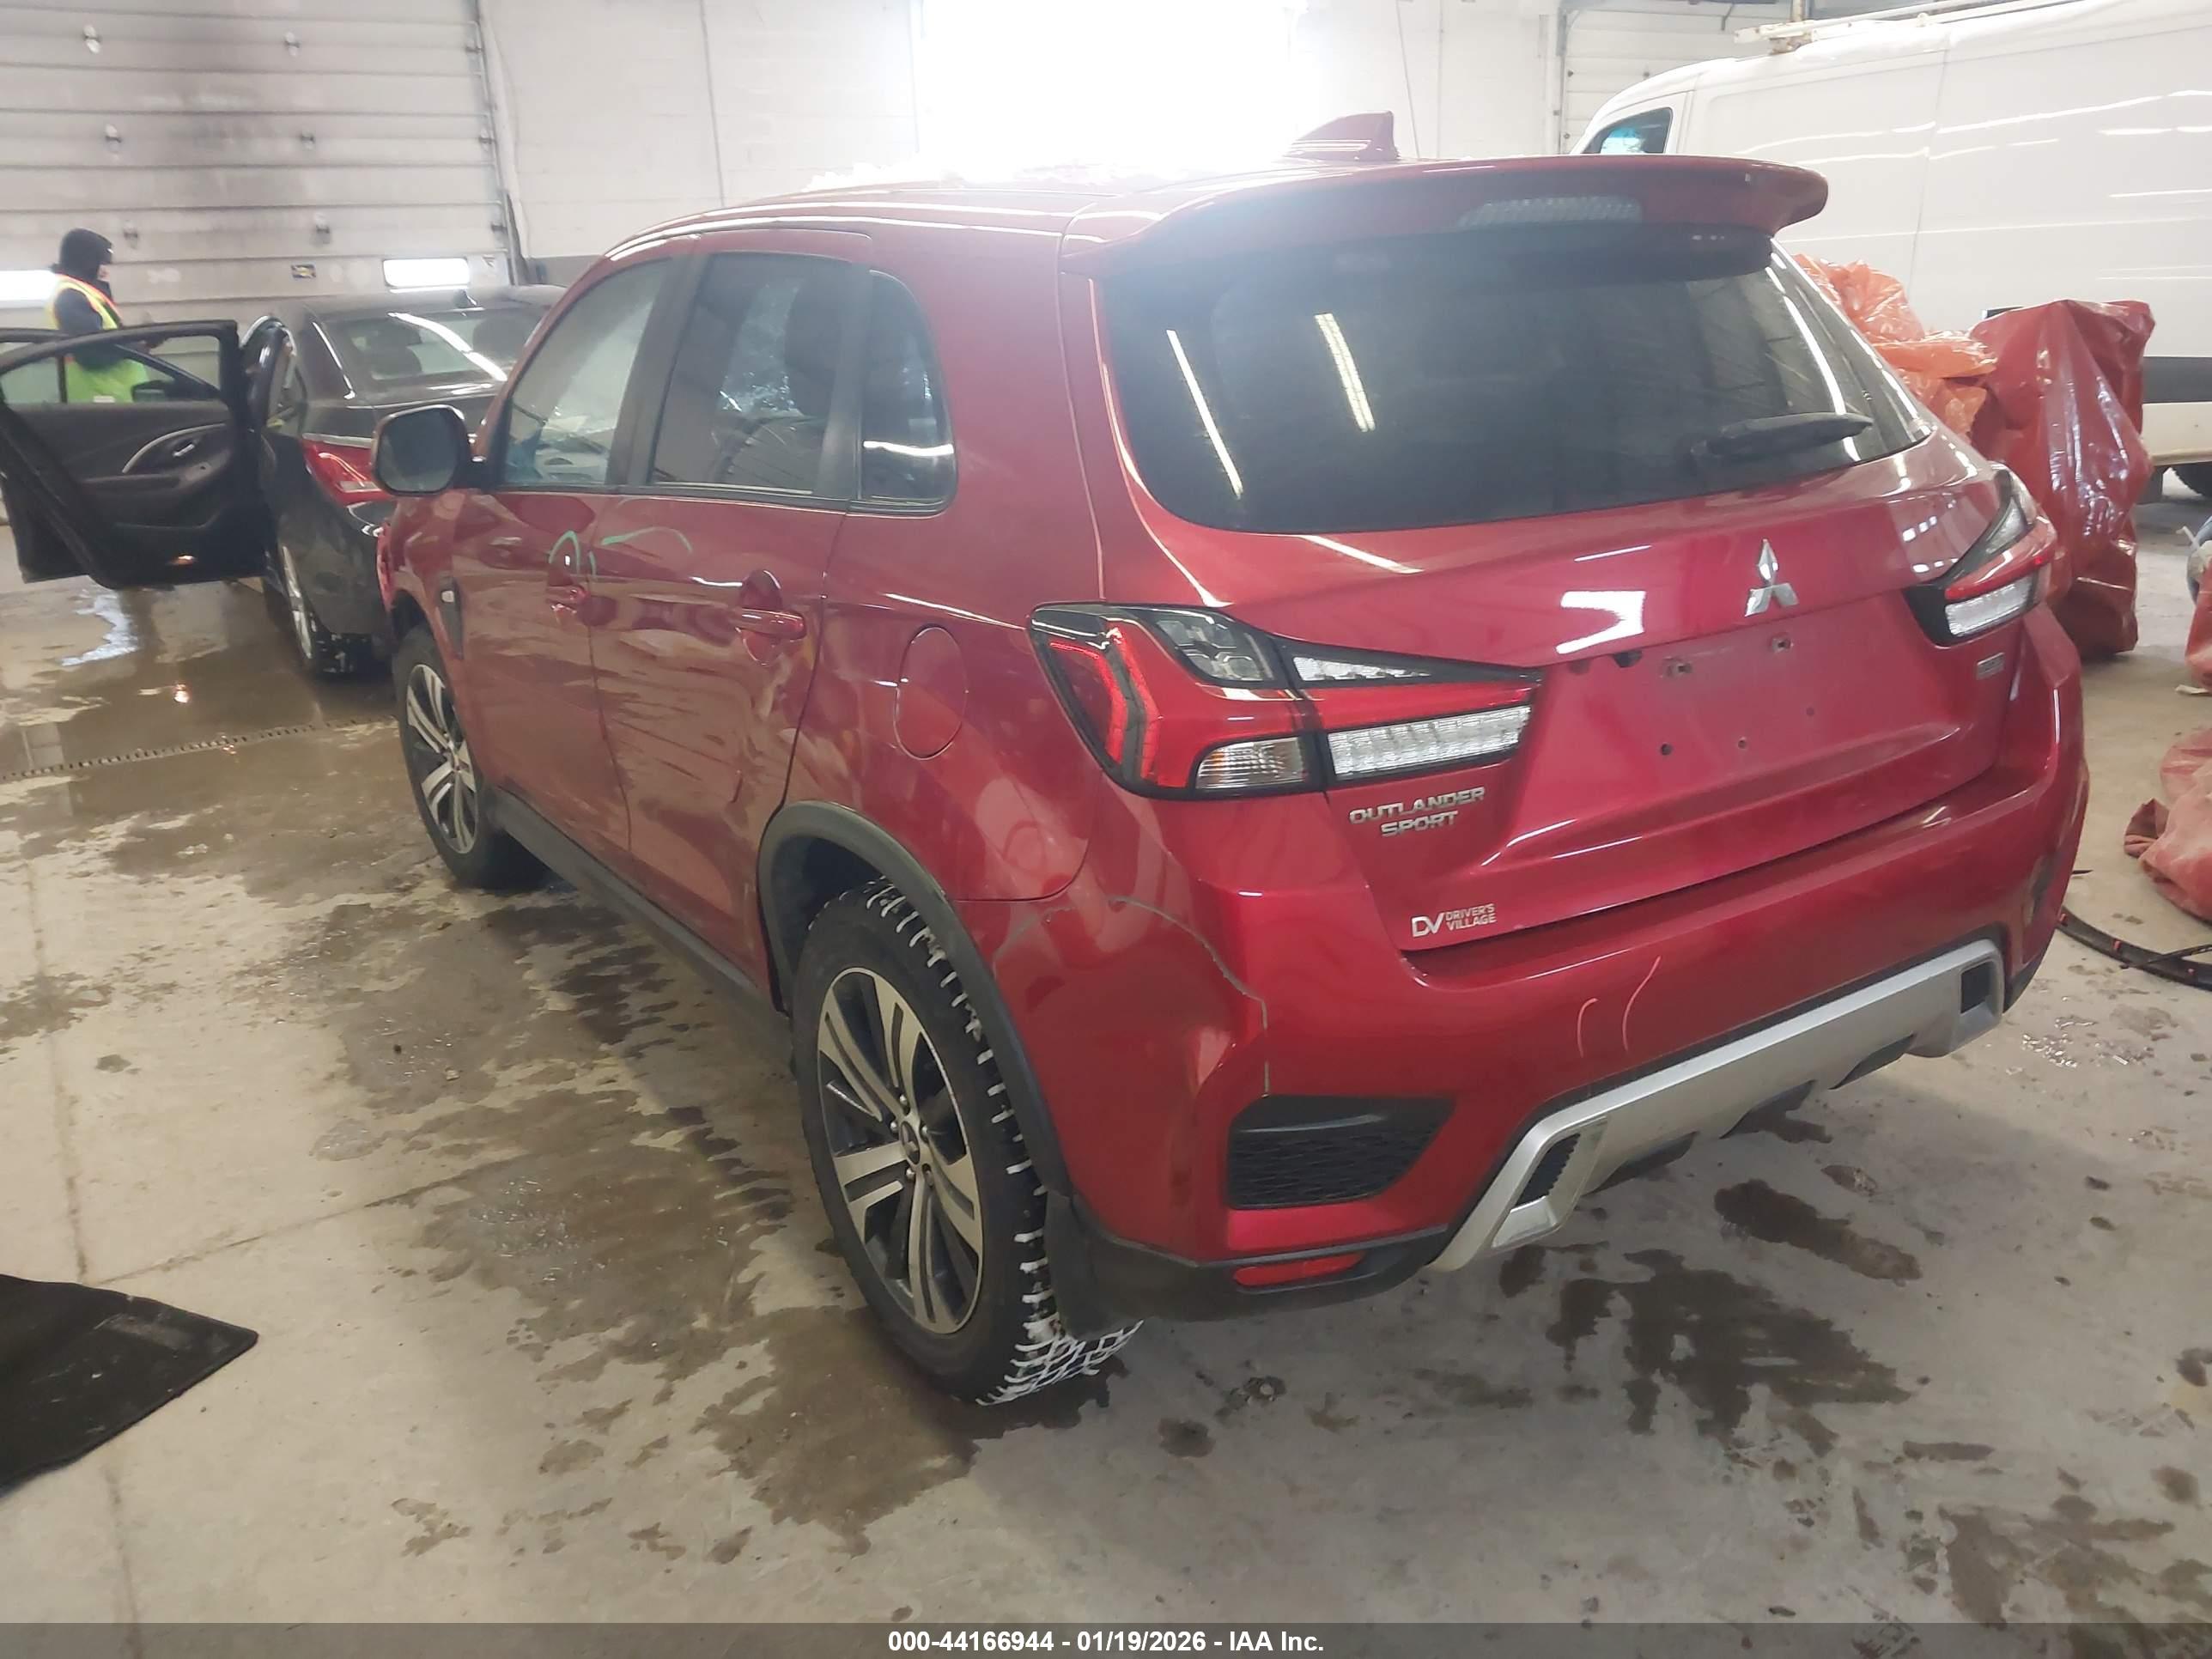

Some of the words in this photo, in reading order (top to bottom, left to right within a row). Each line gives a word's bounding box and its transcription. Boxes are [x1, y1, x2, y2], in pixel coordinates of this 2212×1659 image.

[1349, 787, 1486, 824] OUTLANDER
[1381, 811, 1458, 837] SPORT
[1445, 903, 1496, 921] DRIVER'S
[1446, 913, 1497, 931] VILLAGE
[1412, 913, 1444, 938] DV
